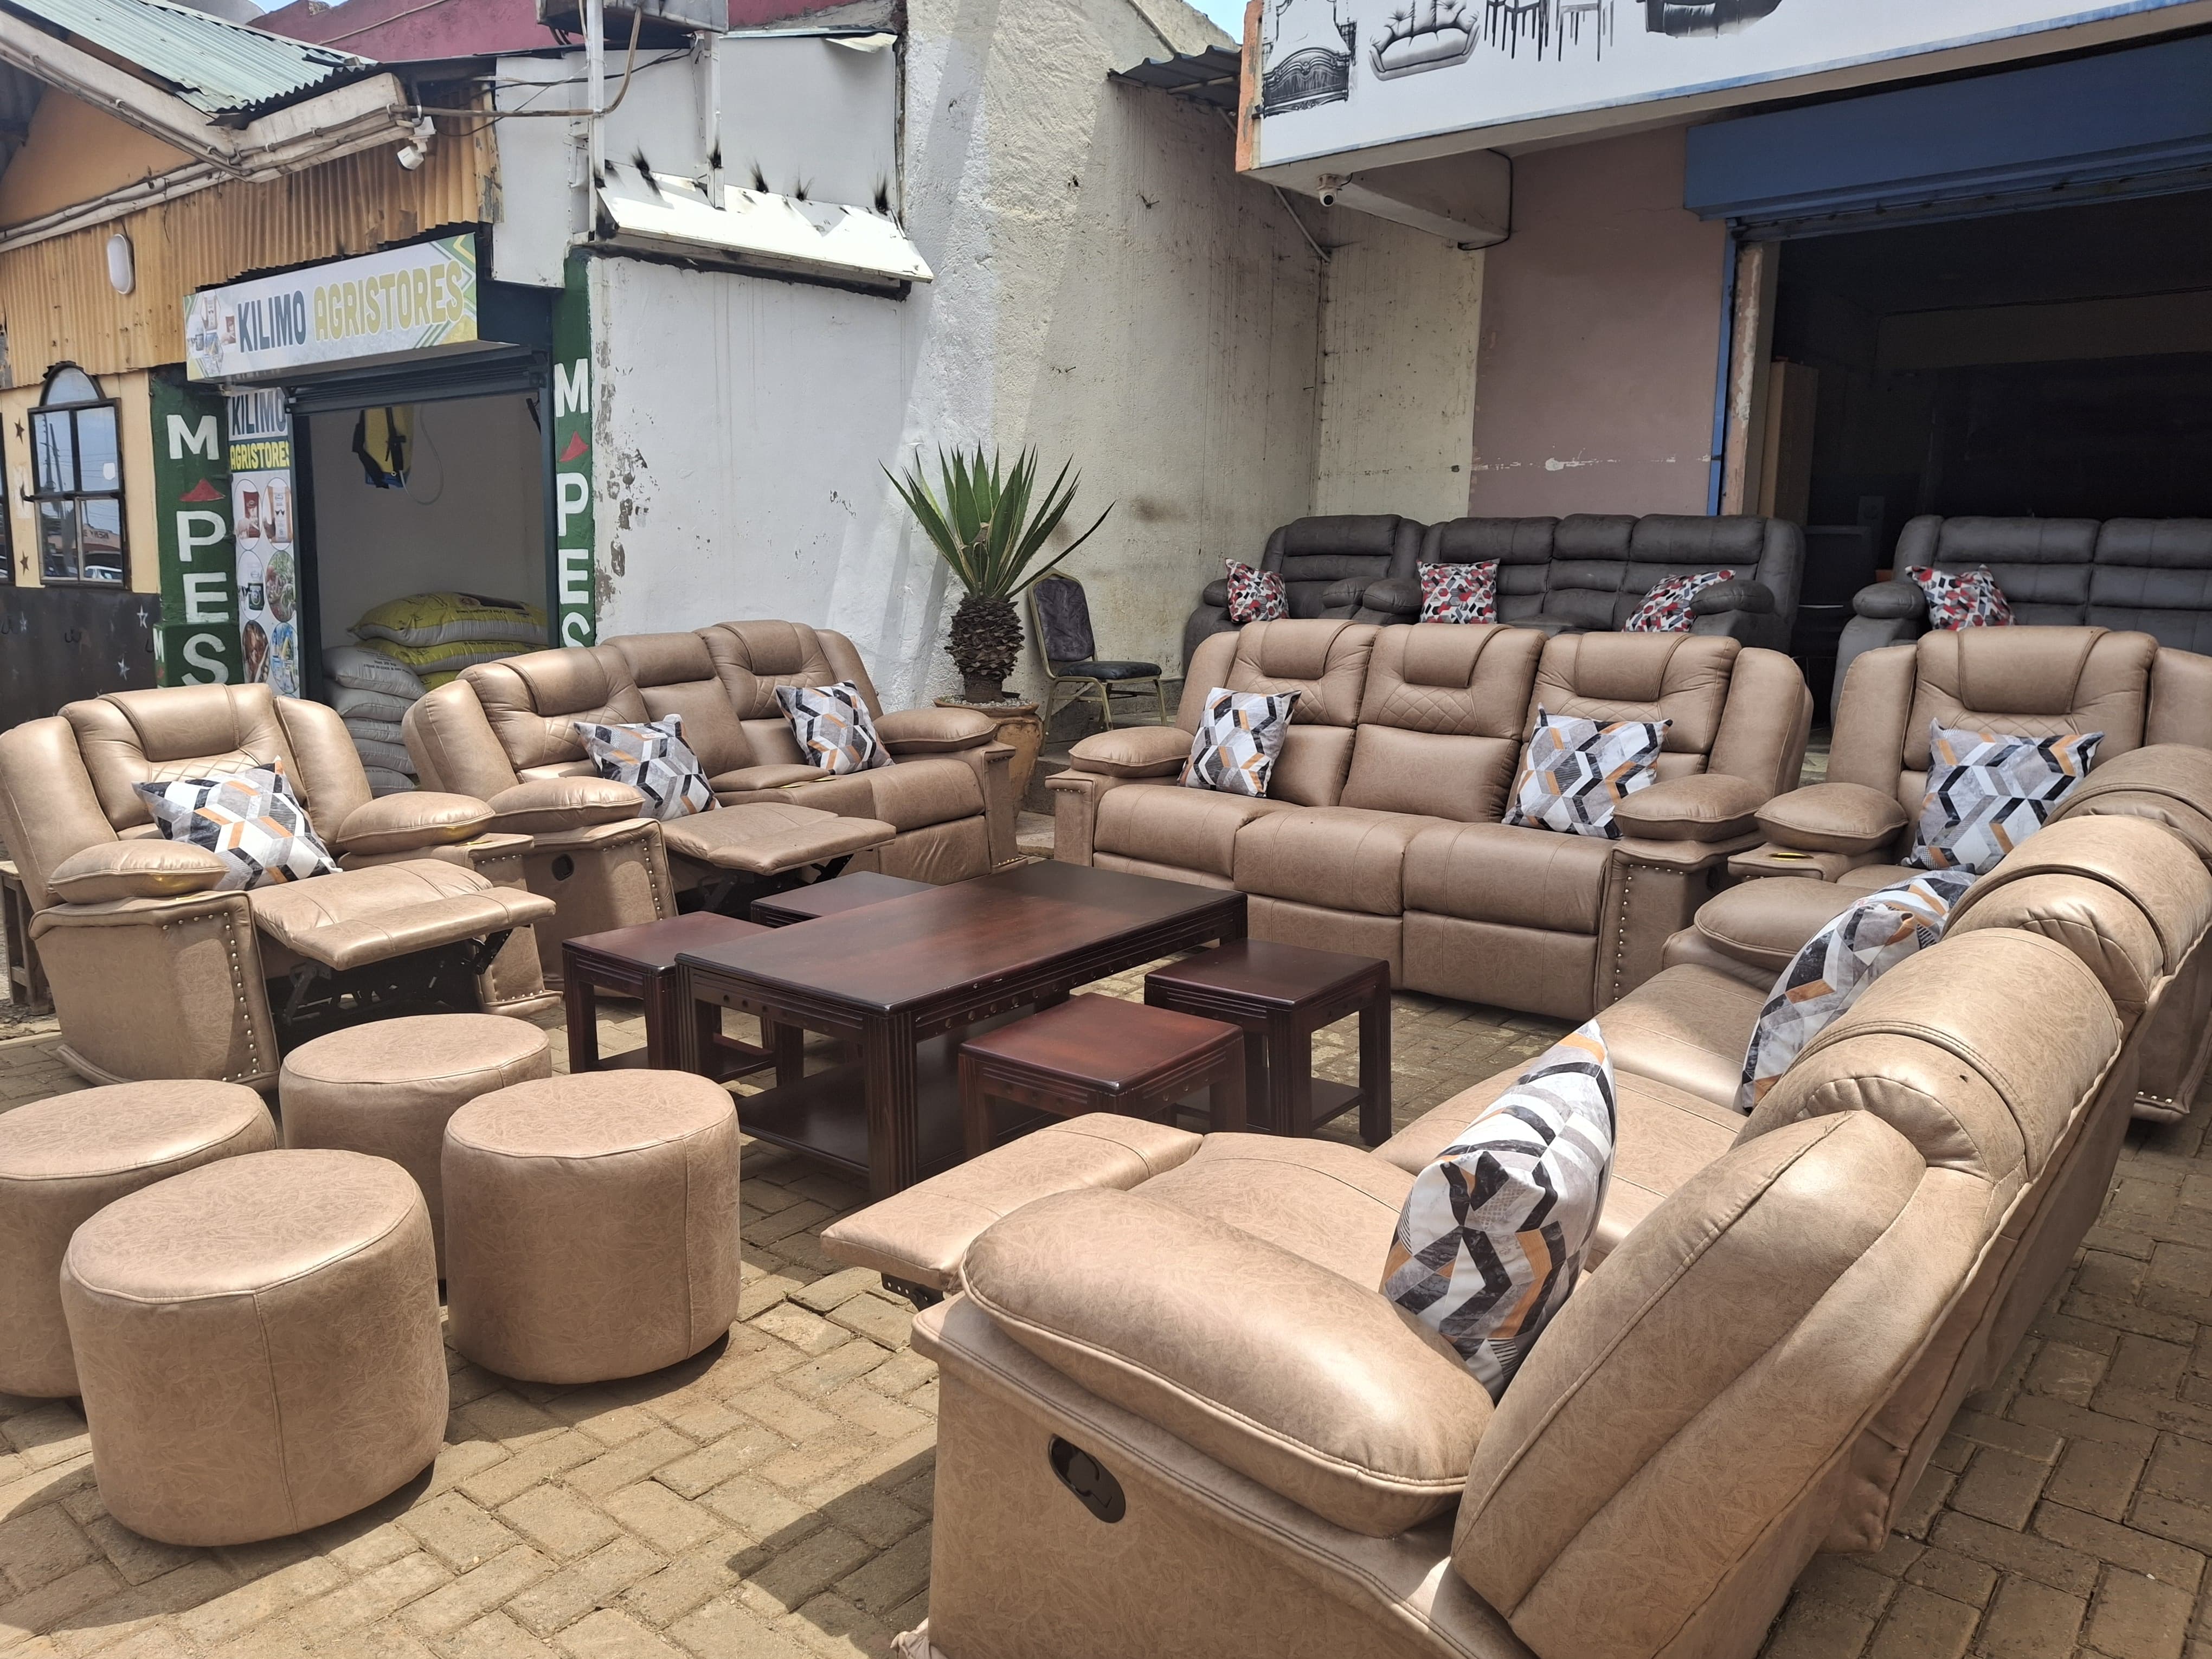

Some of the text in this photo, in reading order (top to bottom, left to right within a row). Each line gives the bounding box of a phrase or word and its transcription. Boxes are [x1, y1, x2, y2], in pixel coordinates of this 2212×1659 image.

[237, 260, 465, 353] KILIMO AGRISTORES
[232, 389, 286, 436] KILIMO
